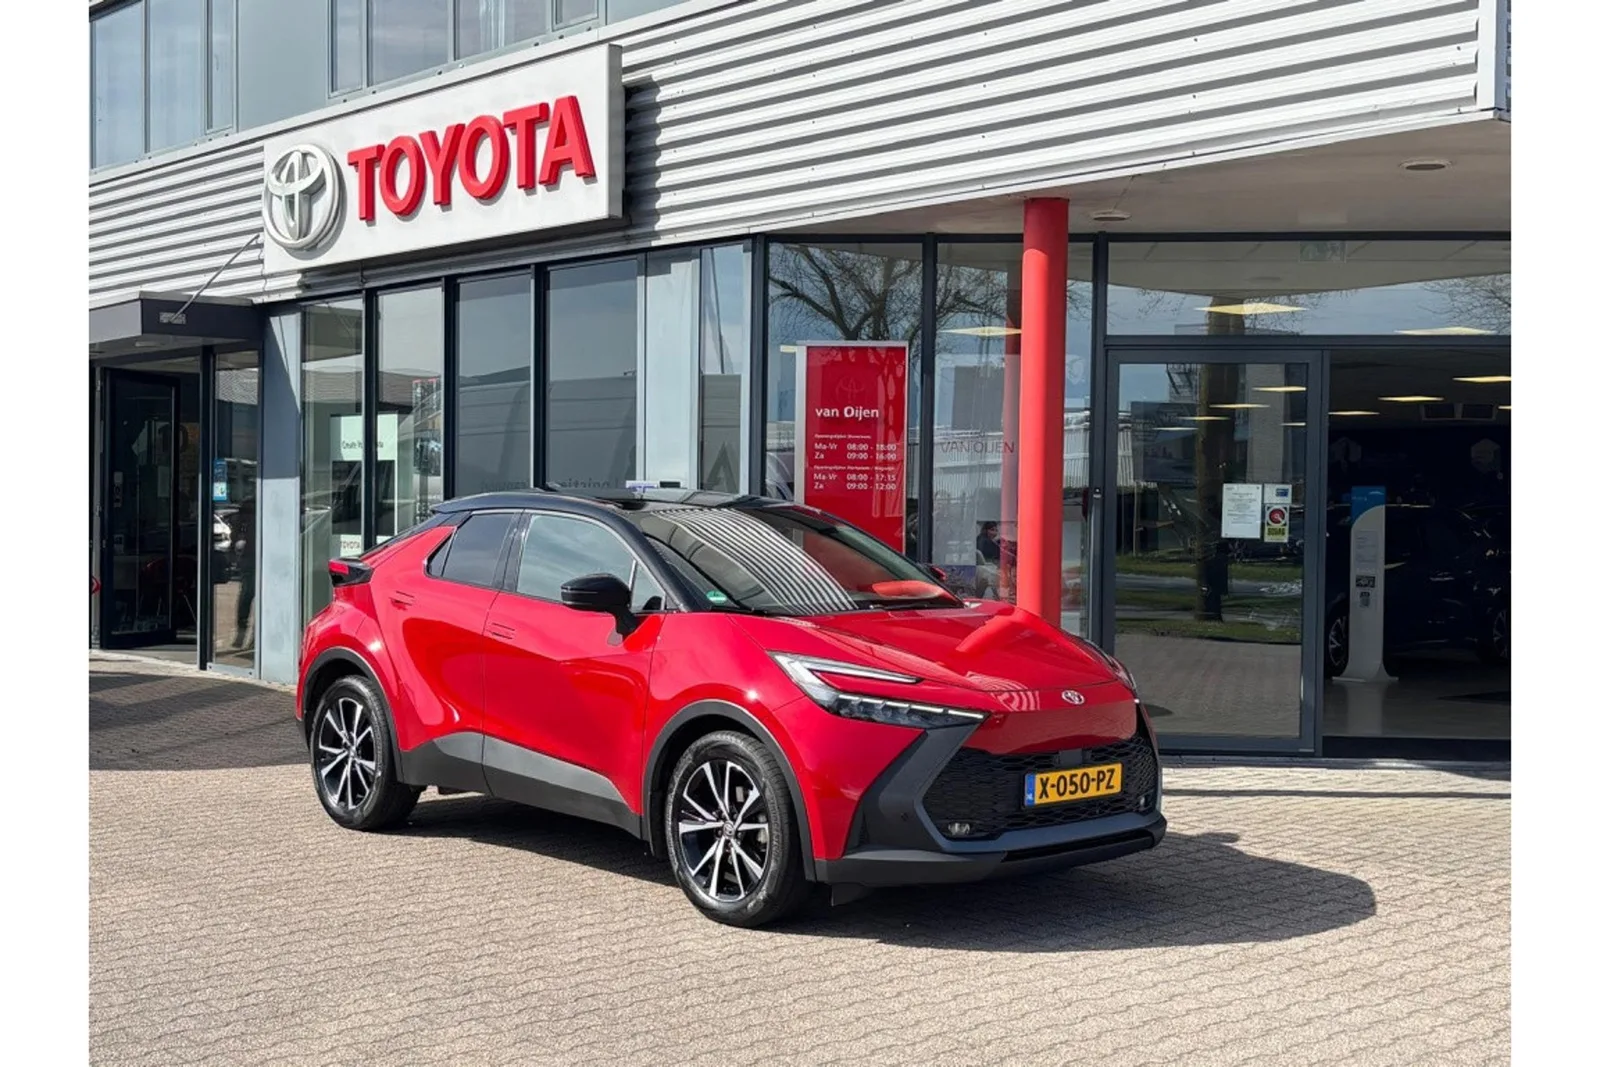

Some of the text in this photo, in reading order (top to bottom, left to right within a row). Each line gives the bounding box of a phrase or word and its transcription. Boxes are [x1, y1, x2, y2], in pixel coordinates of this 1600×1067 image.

[347, 95, 596, 221] TOYOTA
[815, 405, 880, 421] van Oijen
[814, 442, 838, 451] Ma-Vr
[846, 443, 869, 451] 08:00
[814, 451, 825, 460] Za
[846, 452, 869, 460] 09:00
[813, 473, 838, 481] Ma-Vr
[846, 473, 869, 482] 08:00
[875, 473, 897, 482] 17:15
[813, 482, 825, 490] Za
[846, 482, 869, 490] 09:00
[875, 482, 897, 491] 12:00
[1039, 768, 1116, 800] X-050-PZ
